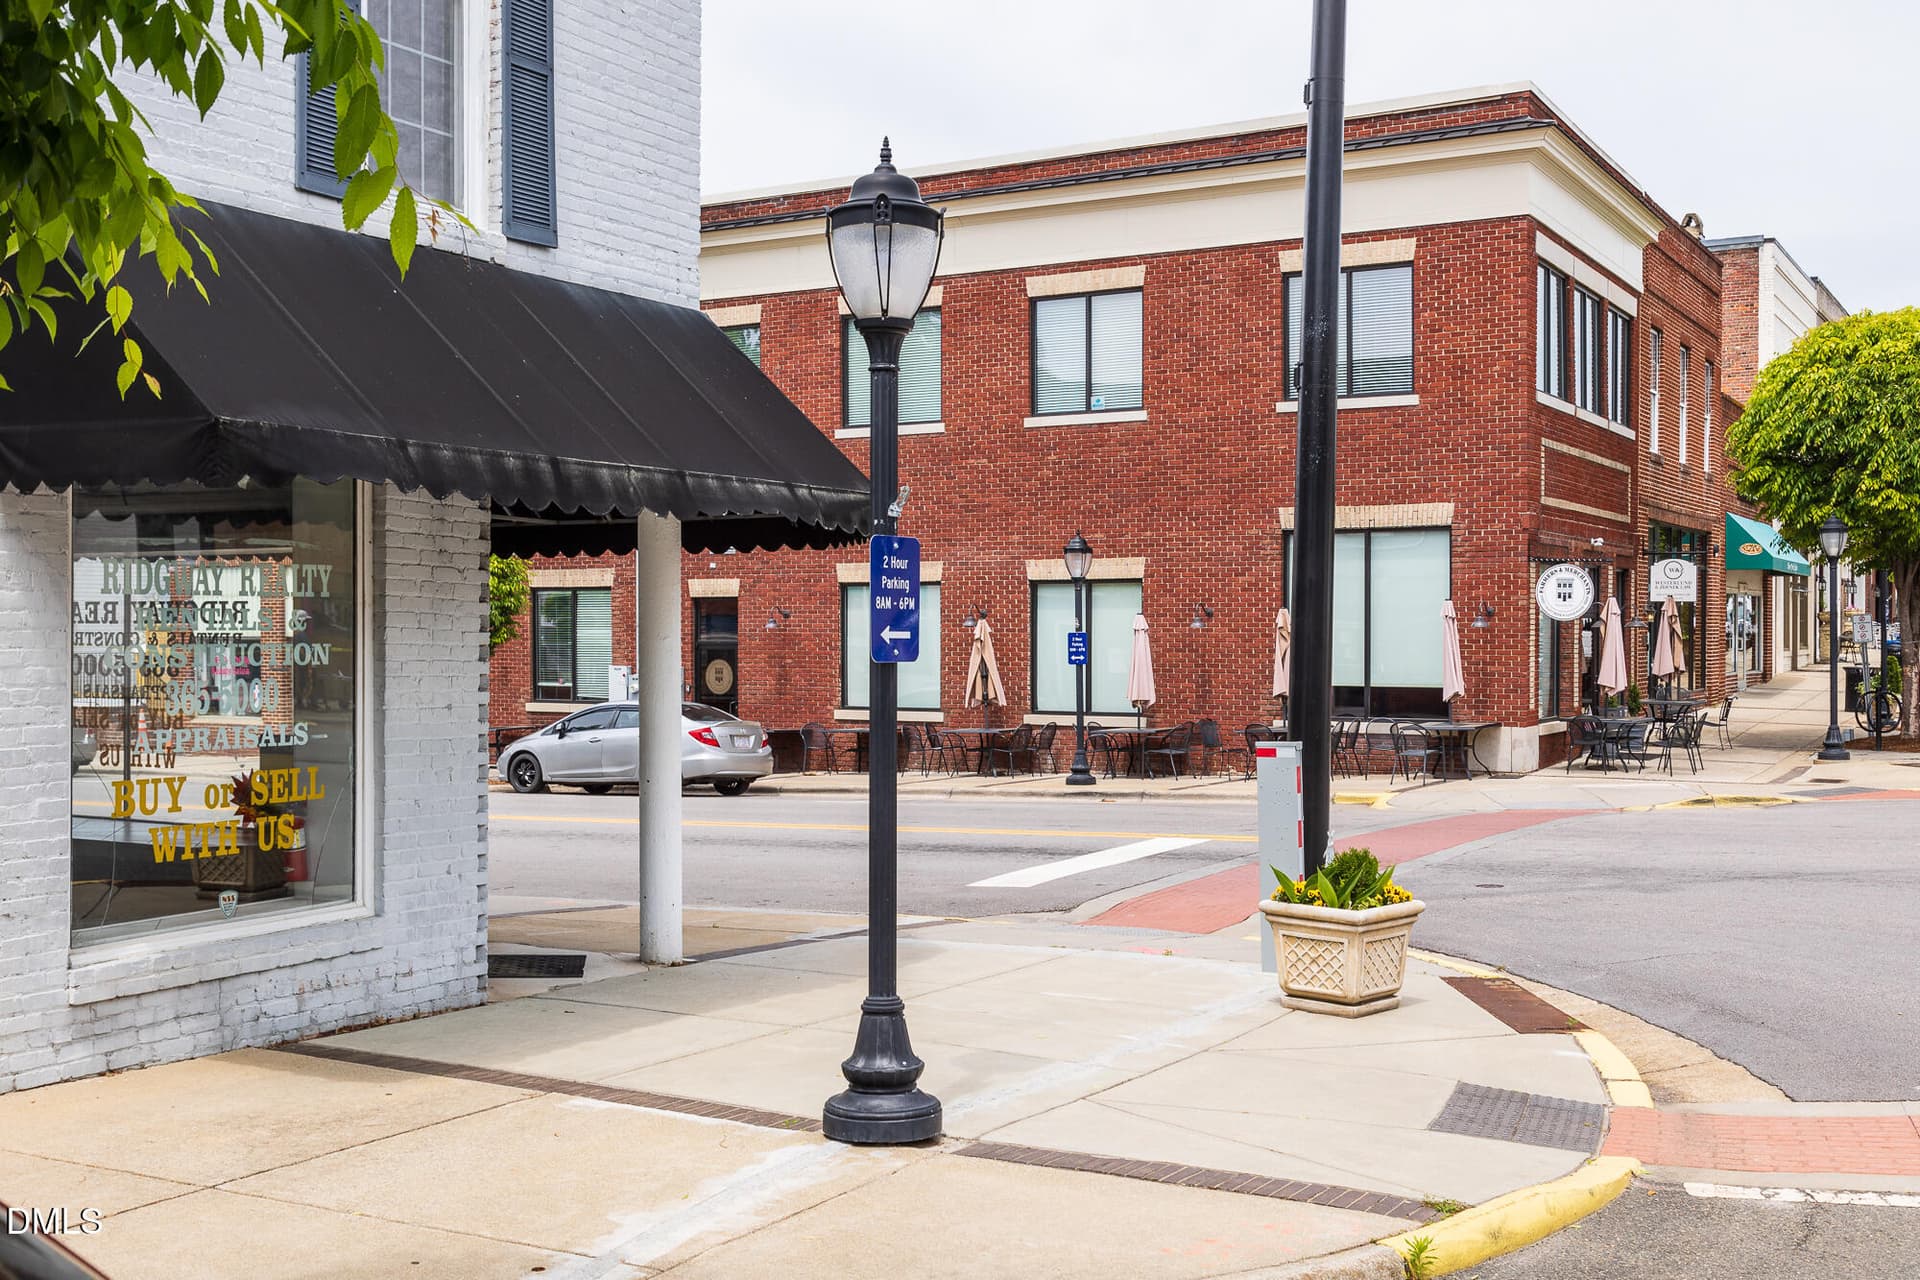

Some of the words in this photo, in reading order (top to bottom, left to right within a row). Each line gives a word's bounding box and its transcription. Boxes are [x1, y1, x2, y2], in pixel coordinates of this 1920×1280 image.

[882, 555, 889, 569] 2
[890, 556, 909, 569] Hour
[101, 558, 223, 596] RIDGWAY
[238, 563, 333, 598] REALTY
[881, 575, 910, 593] Parking
[1539, 569, 1557, 593] FARMERS
[1564, 567, 1591, 595] MERCHANTS
[875, 596, 892, 609] 8AM
[898, 596, 916, 610] 6PM
[135, 607, 273, 631] RENTALS
[288, 610, 308, 632] &
[103, 642, 332, 669] CONSTRUCTION
[166, 677, 279, 716] 365-5000
[133, 722, 309, 754] APPRAISALS
[111, 776, 187, 819] BUY
[204, 782, 234, 809] or
[251, 766, 325, 806] SELL
[149, 820, 240, 864] WITH
[256, 813, 295, 851] US
